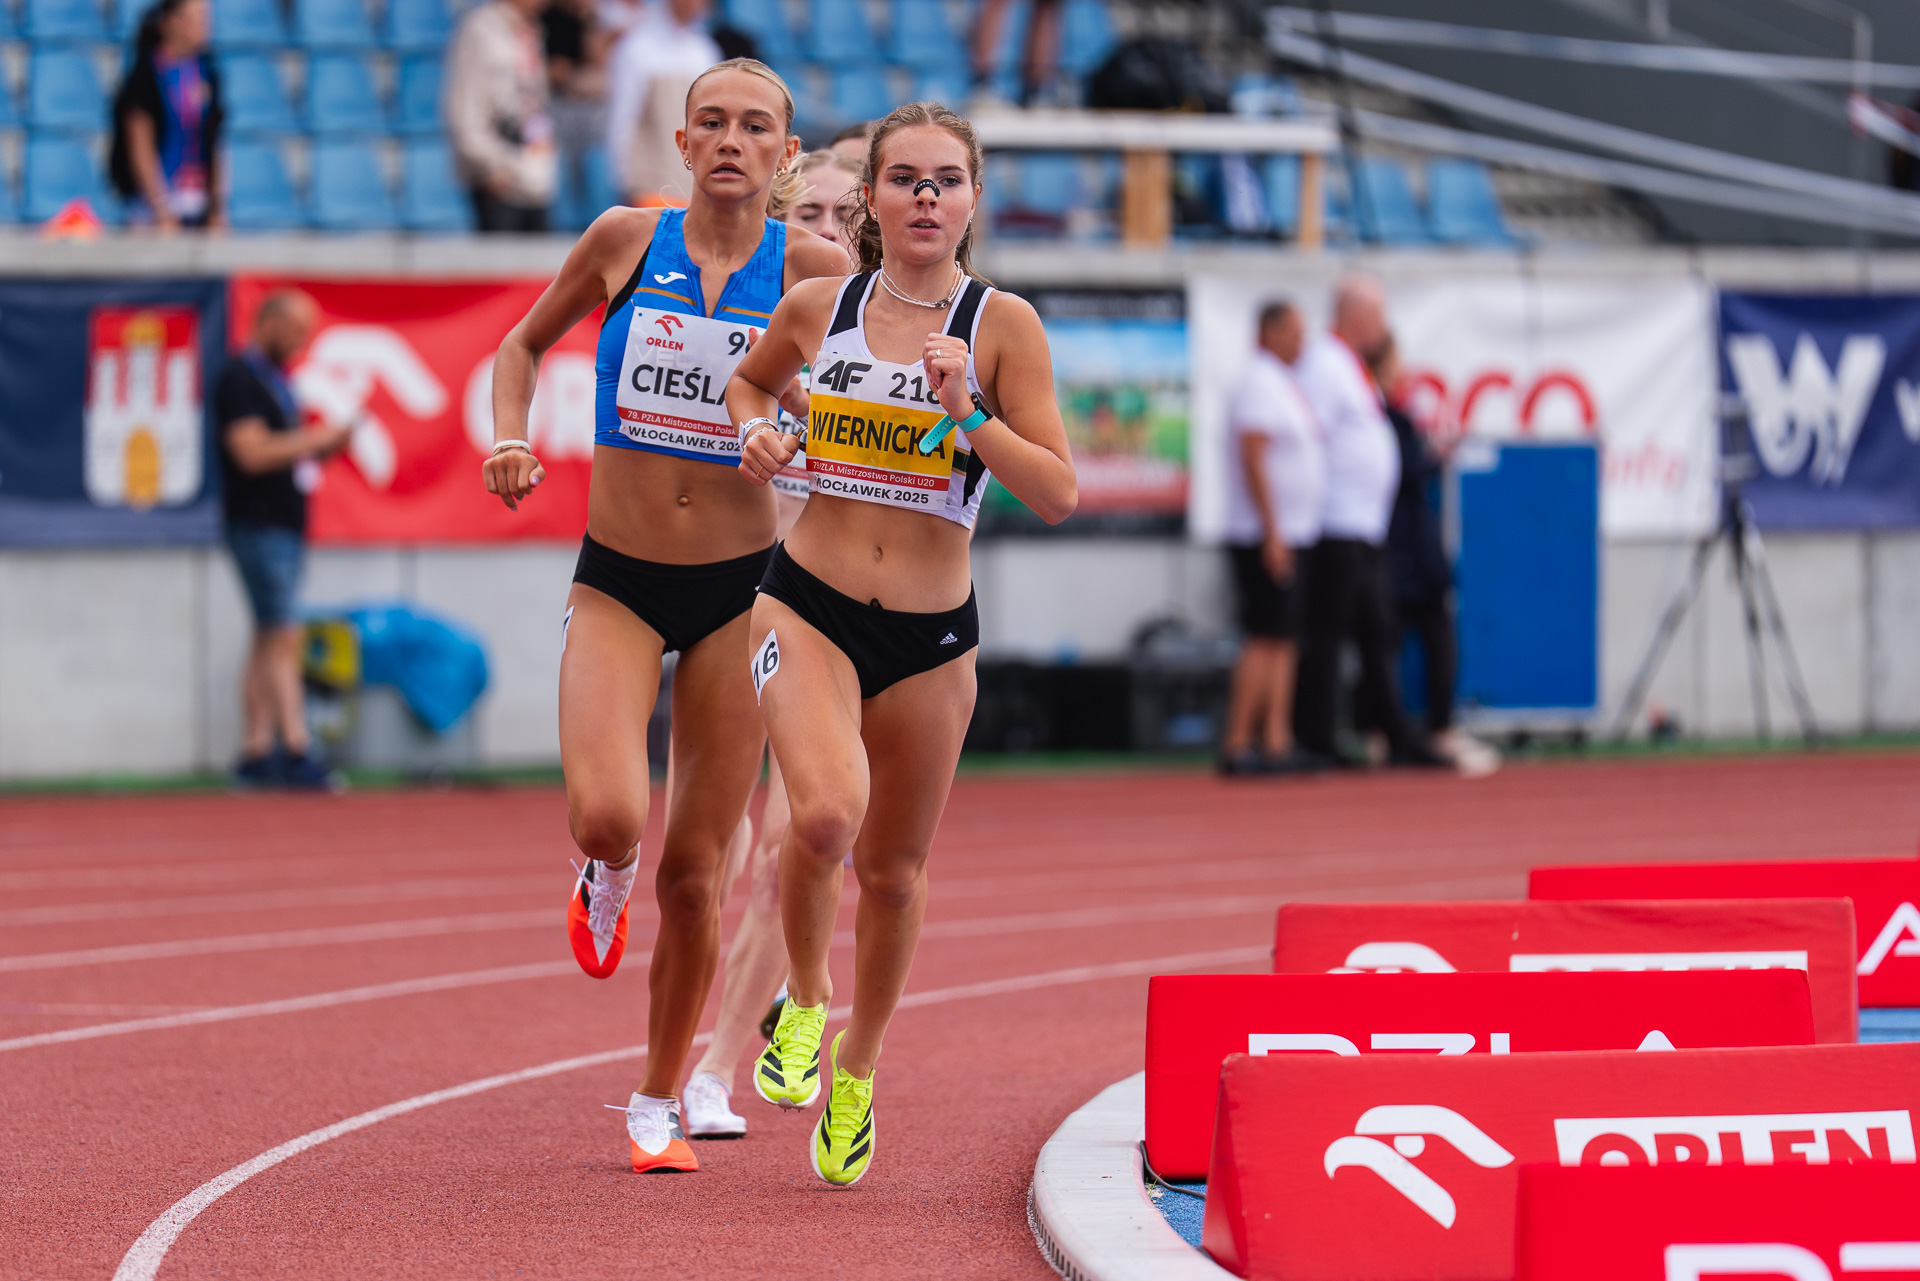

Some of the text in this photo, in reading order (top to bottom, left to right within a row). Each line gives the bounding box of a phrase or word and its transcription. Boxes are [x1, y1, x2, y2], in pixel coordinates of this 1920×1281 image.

[646, 336, 684, 351] ORLEN
[728, 331, 751, 356] 9
[818, 360, 873, 393] 4F
[627, 410, 736, 436] 79. PZLA Mistrzostwa Polsk
[812, 410, 946, 460] WIERNICKA
[628, 425, 741, 452] WŁOCŁAWEK 202
[836, 465, 888, 482] Mistrzostwa
[889, 474, 916, 486] Polski
[917, 478, 935, 488] U20
[894, 490, 929, 505] 2025
[753, 640, 778, 691] 16
